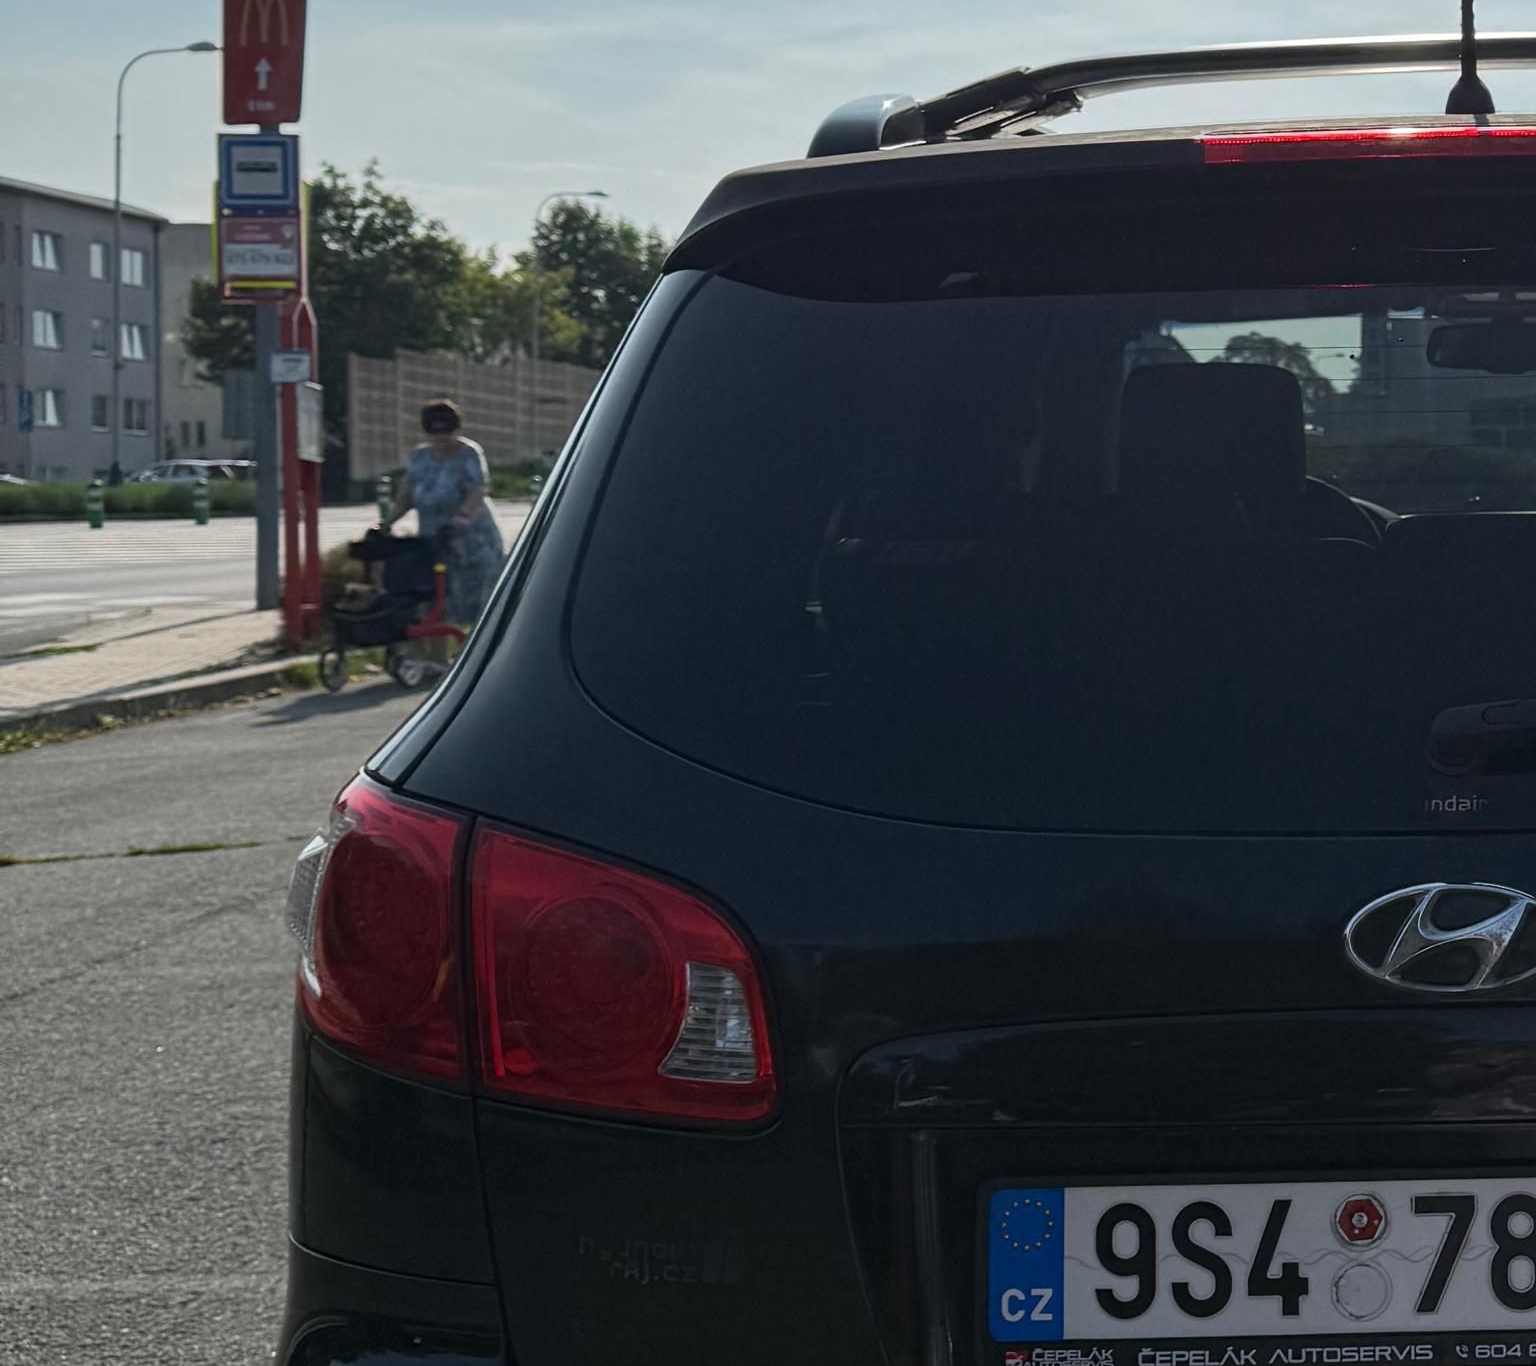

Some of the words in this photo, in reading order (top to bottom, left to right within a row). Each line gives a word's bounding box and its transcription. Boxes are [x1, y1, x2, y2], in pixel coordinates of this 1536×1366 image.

[1095, 1199, 1309, 1320] 9S4
[1001, 1288, 1053, 1322] CZ
[1138, 1346, 1257, 1366] ČEPELÁK
[1269, 1344, 1434, 1365] AUTOSERVIS
[1475, 1344, 1522, 1358] 604
